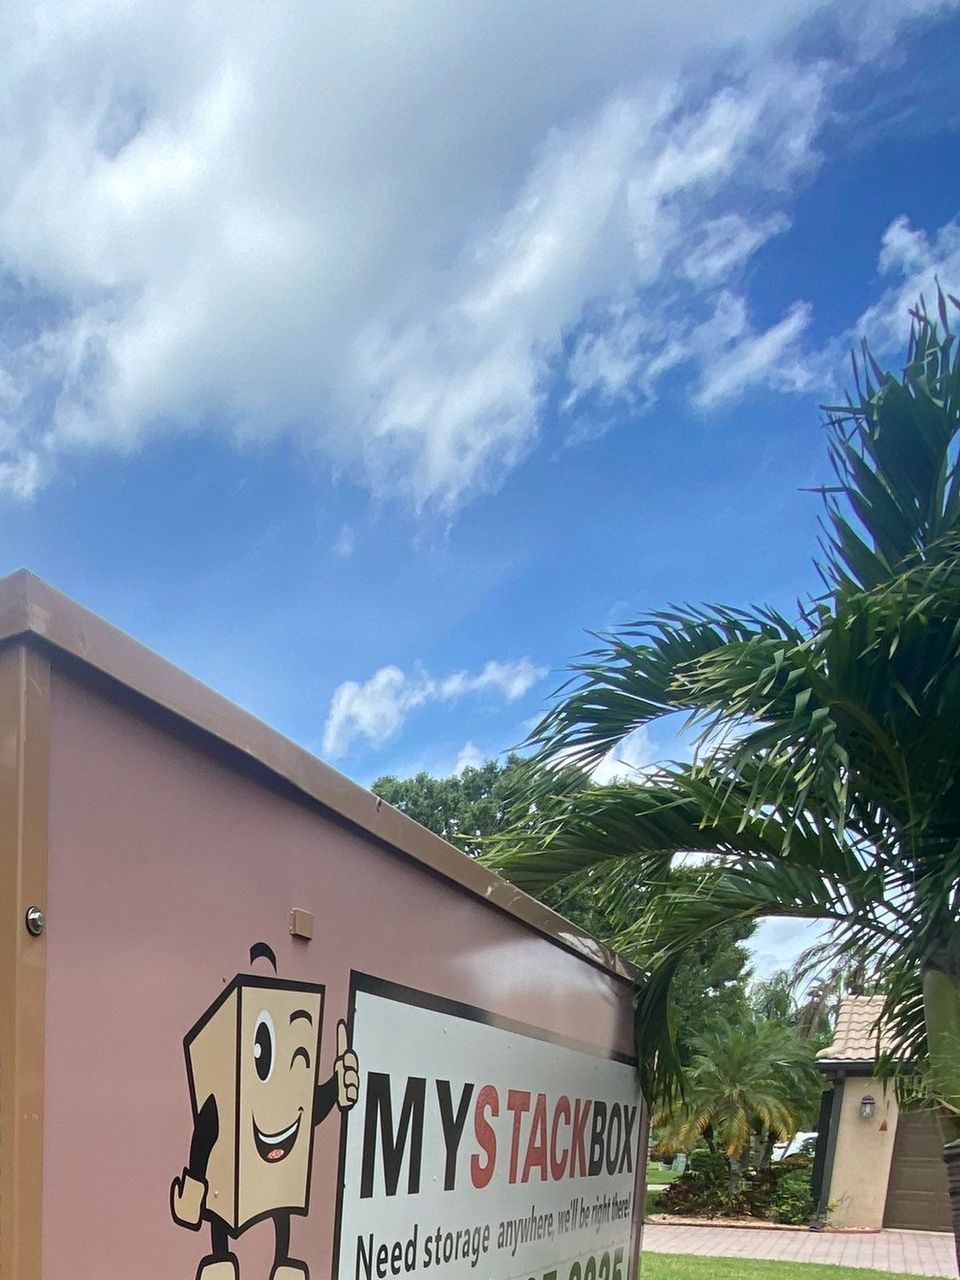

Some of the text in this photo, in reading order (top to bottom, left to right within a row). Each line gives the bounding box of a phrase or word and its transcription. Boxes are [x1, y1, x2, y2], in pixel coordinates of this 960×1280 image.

[360, 1071, 637, 1199] MYSTACKBOX
[423, 1223, 490, 1268] storage
[497, 1204, 554, 1257] anywhere,
[558, 1198, 579, 1235] we'll
[579, 1197, 591, 1229] be
[591, 1193, 611, 1233] right
[611, 1191, 632, 1221] there!
